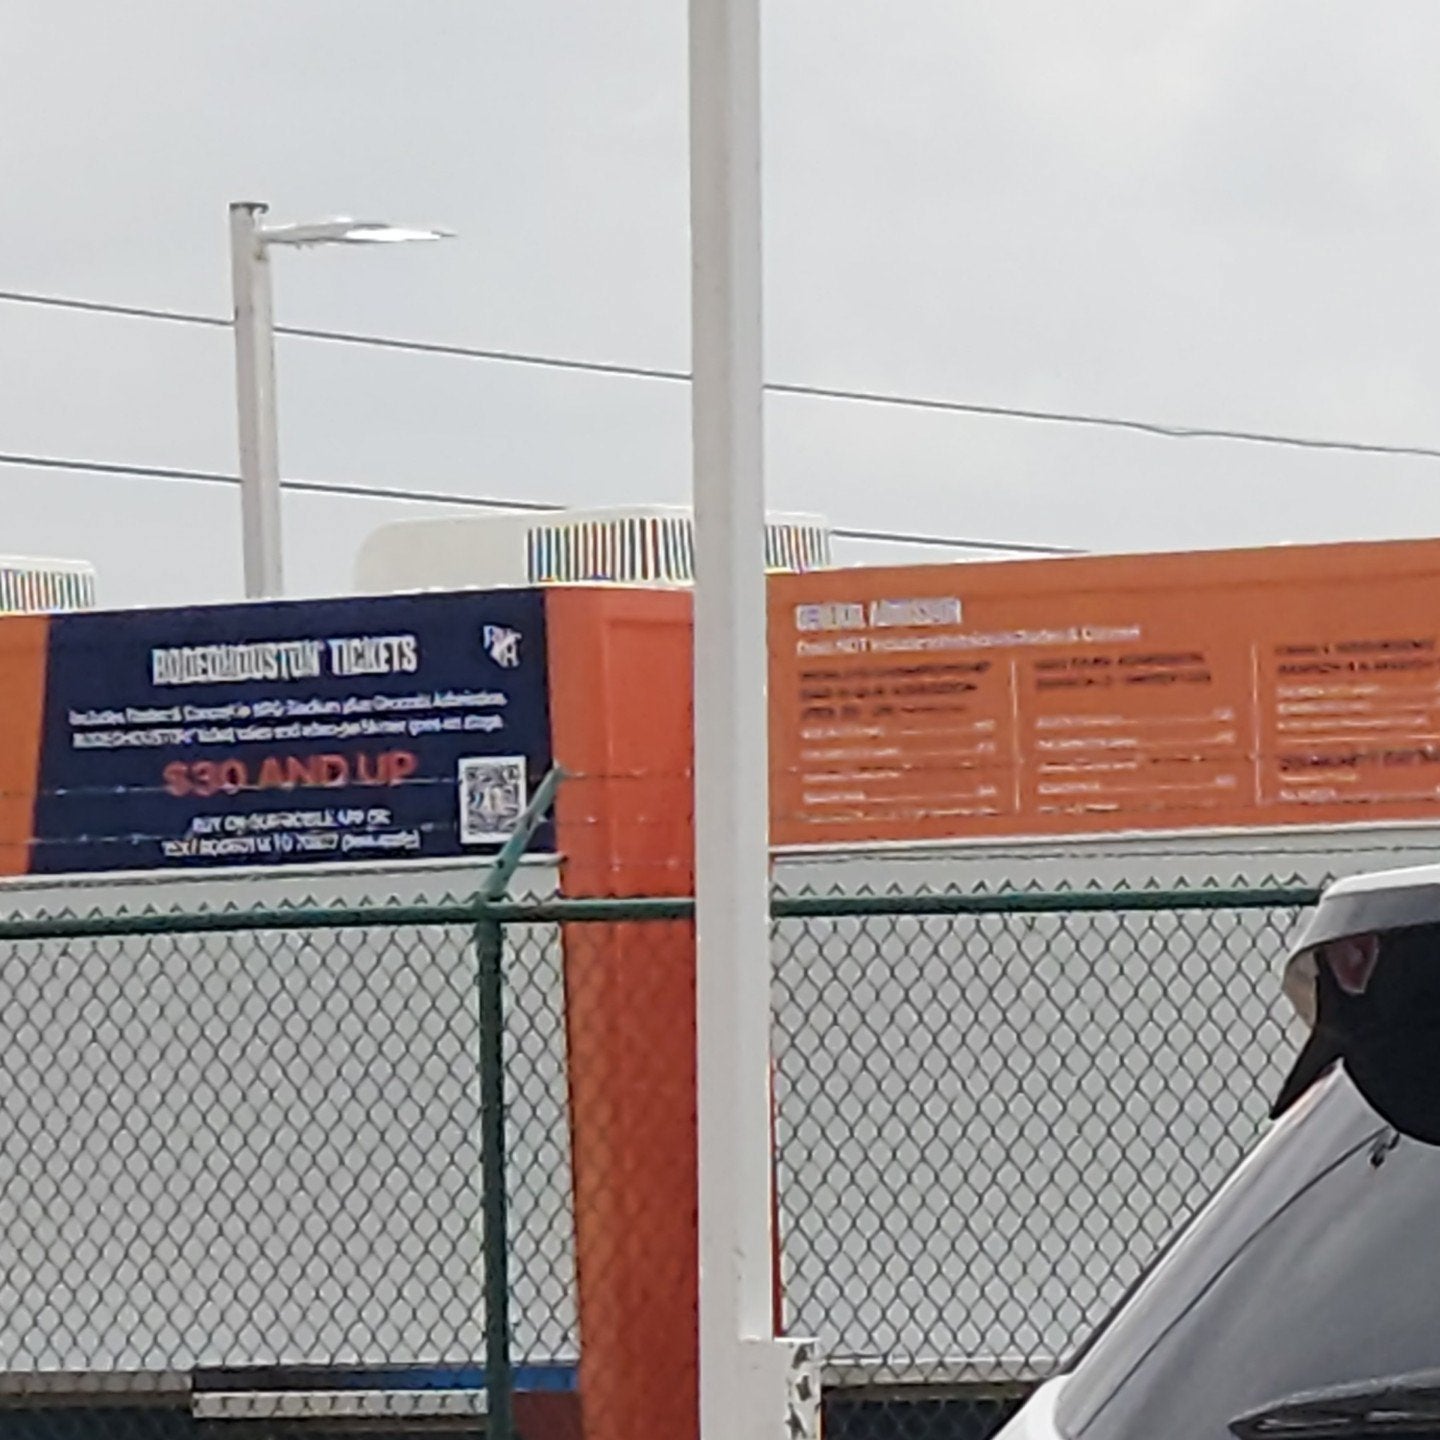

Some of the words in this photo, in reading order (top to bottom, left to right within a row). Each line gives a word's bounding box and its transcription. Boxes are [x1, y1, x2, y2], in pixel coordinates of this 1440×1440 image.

[327, 634, 418, 677] TICKETS
[163, 759, 247, 797] $30
[258, 754, 349, 791] AND
[356, 749, 418, 786] UP
